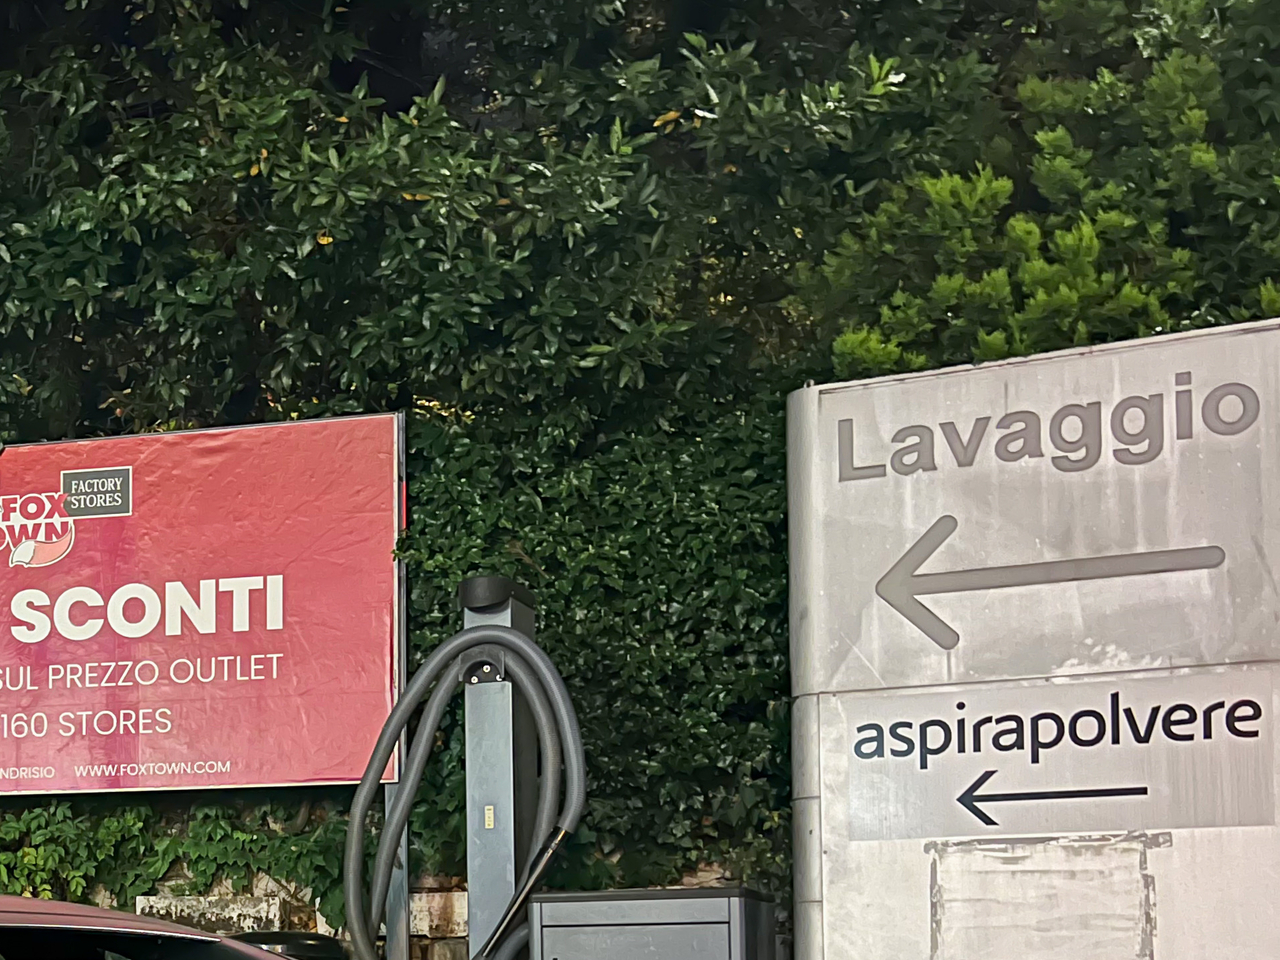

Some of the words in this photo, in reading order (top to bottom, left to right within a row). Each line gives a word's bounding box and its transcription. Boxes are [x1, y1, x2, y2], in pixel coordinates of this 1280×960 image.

[836, 371, 1260, 484] Lavaggio
[71, 477, 124, 494] FACTORY
[71, 493, 123, 509] STORES
[1, 493, 70, 522] FOX
[10, 574, 284, 644] SCONTI
[48, 660, 159, 690] PREZZO
[169, 653, 284, 684] OUTLET
[0, 712, 48, 739] 160
[58, 707, 173, 738] STORES
[853, 691, 1263, 770] aspirapolvere
[74, 760, 232, 777] WWW.FOXTOWN.COM
